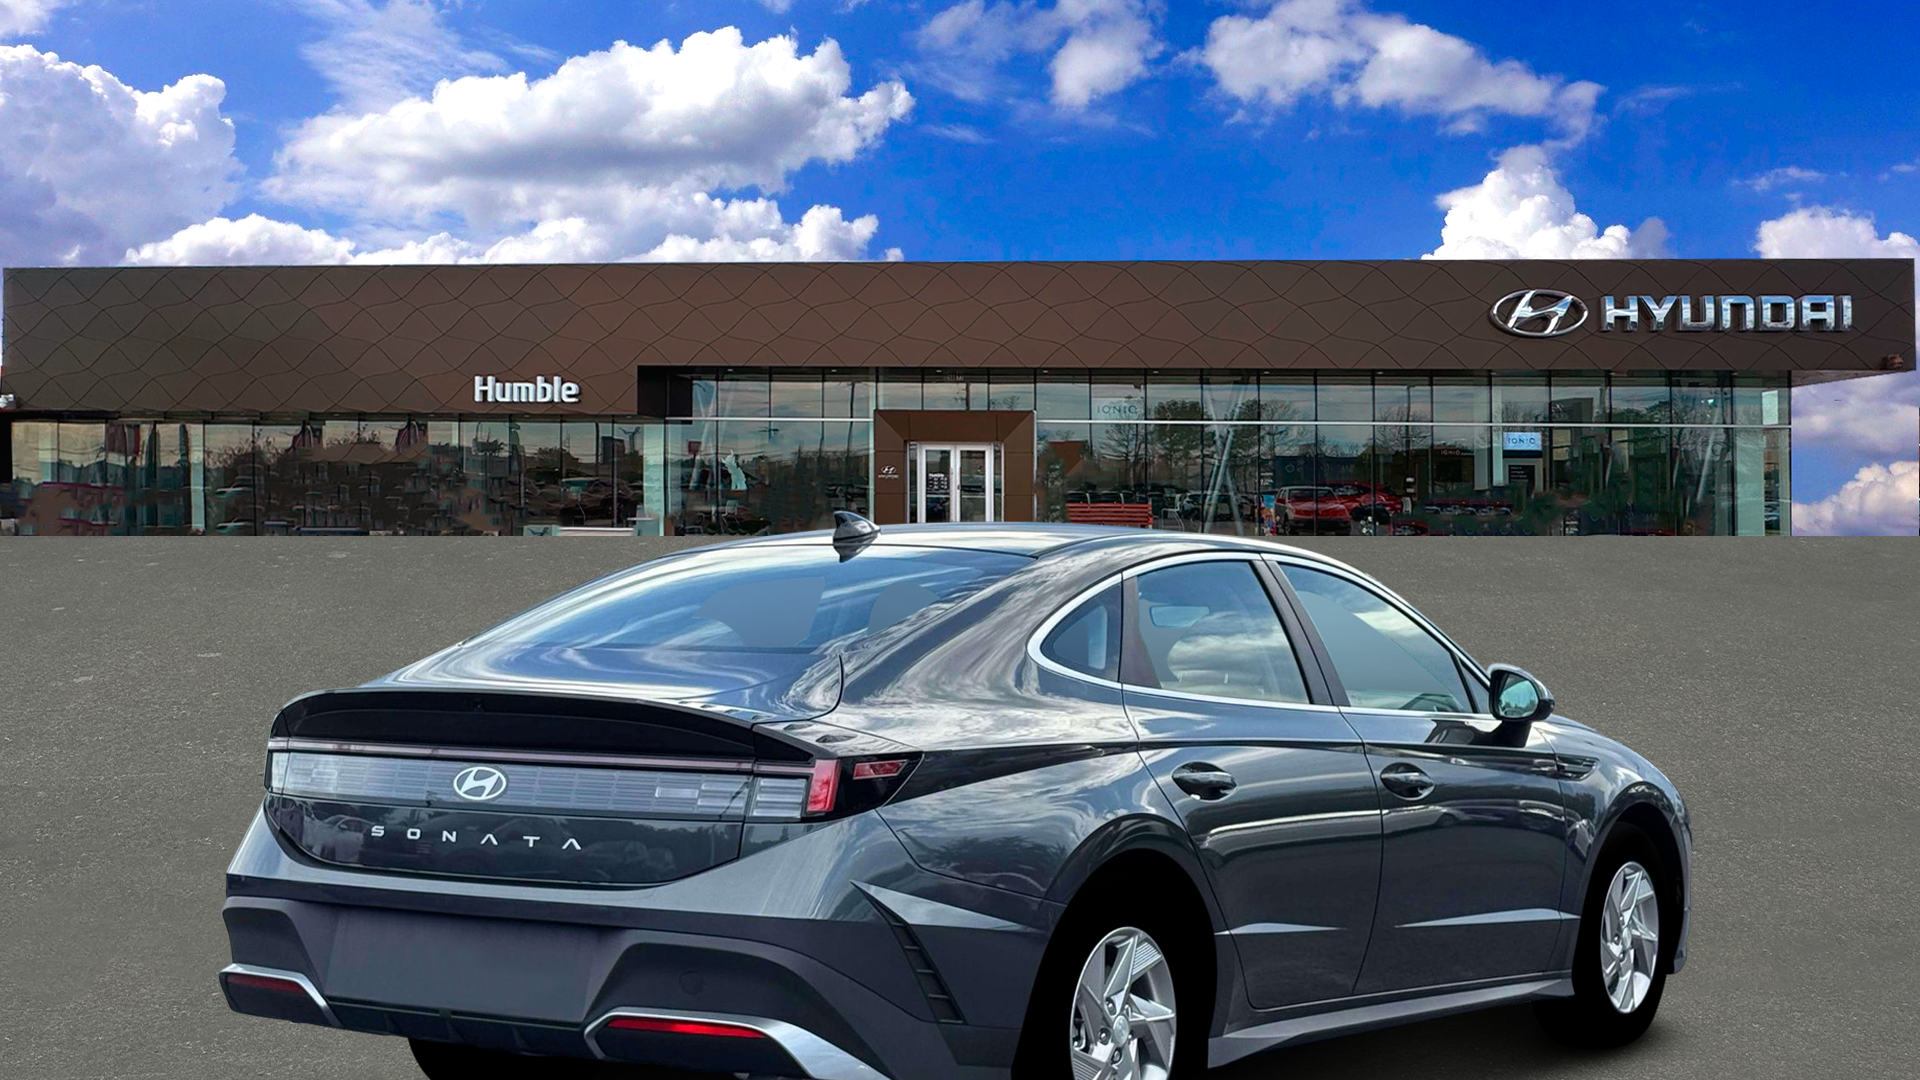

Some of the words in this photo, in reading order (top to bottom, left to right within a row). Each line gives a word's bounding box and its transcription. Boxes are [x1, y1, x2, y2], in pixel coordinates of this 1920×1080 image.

[1602, 295, 1852, 332] HYUNDAI
[474, 375, 580, 402] Humble
[371, 825, 582, 850] SONATA
